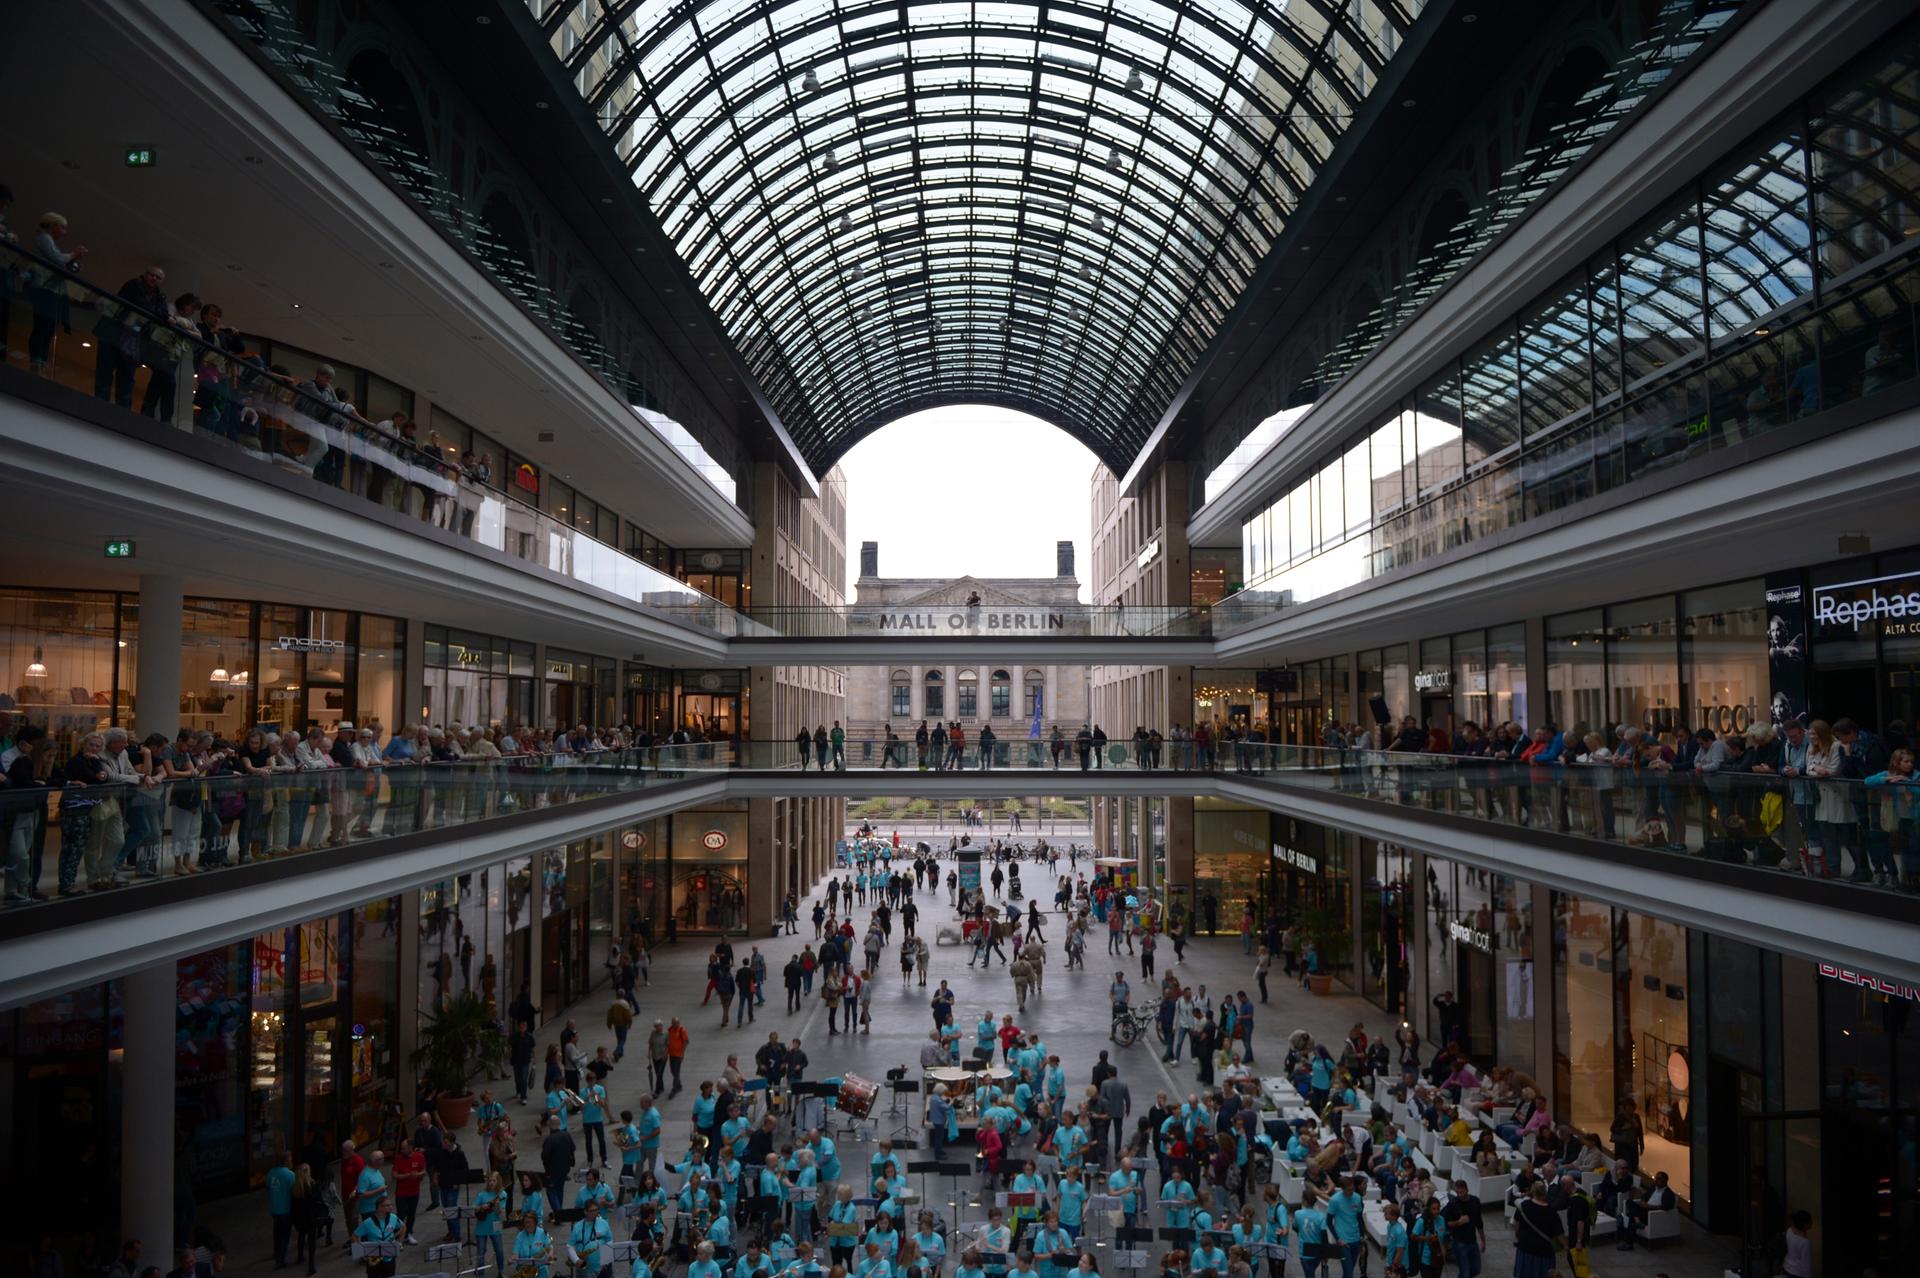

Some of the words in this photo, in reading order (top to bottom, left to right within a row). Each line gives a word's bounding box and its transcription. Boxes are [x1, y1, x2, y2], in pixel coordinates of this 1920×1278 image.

[879, 614, 937, 630] MALL
[948, 613, 979, 629] OF
[987, 613, 1064, 630] BERLIN
[1884, 624, 1907, 636] ALTA
[1287, 848, 1296, 865] OF
[1295, 852, 1317, 875] BERLIN
